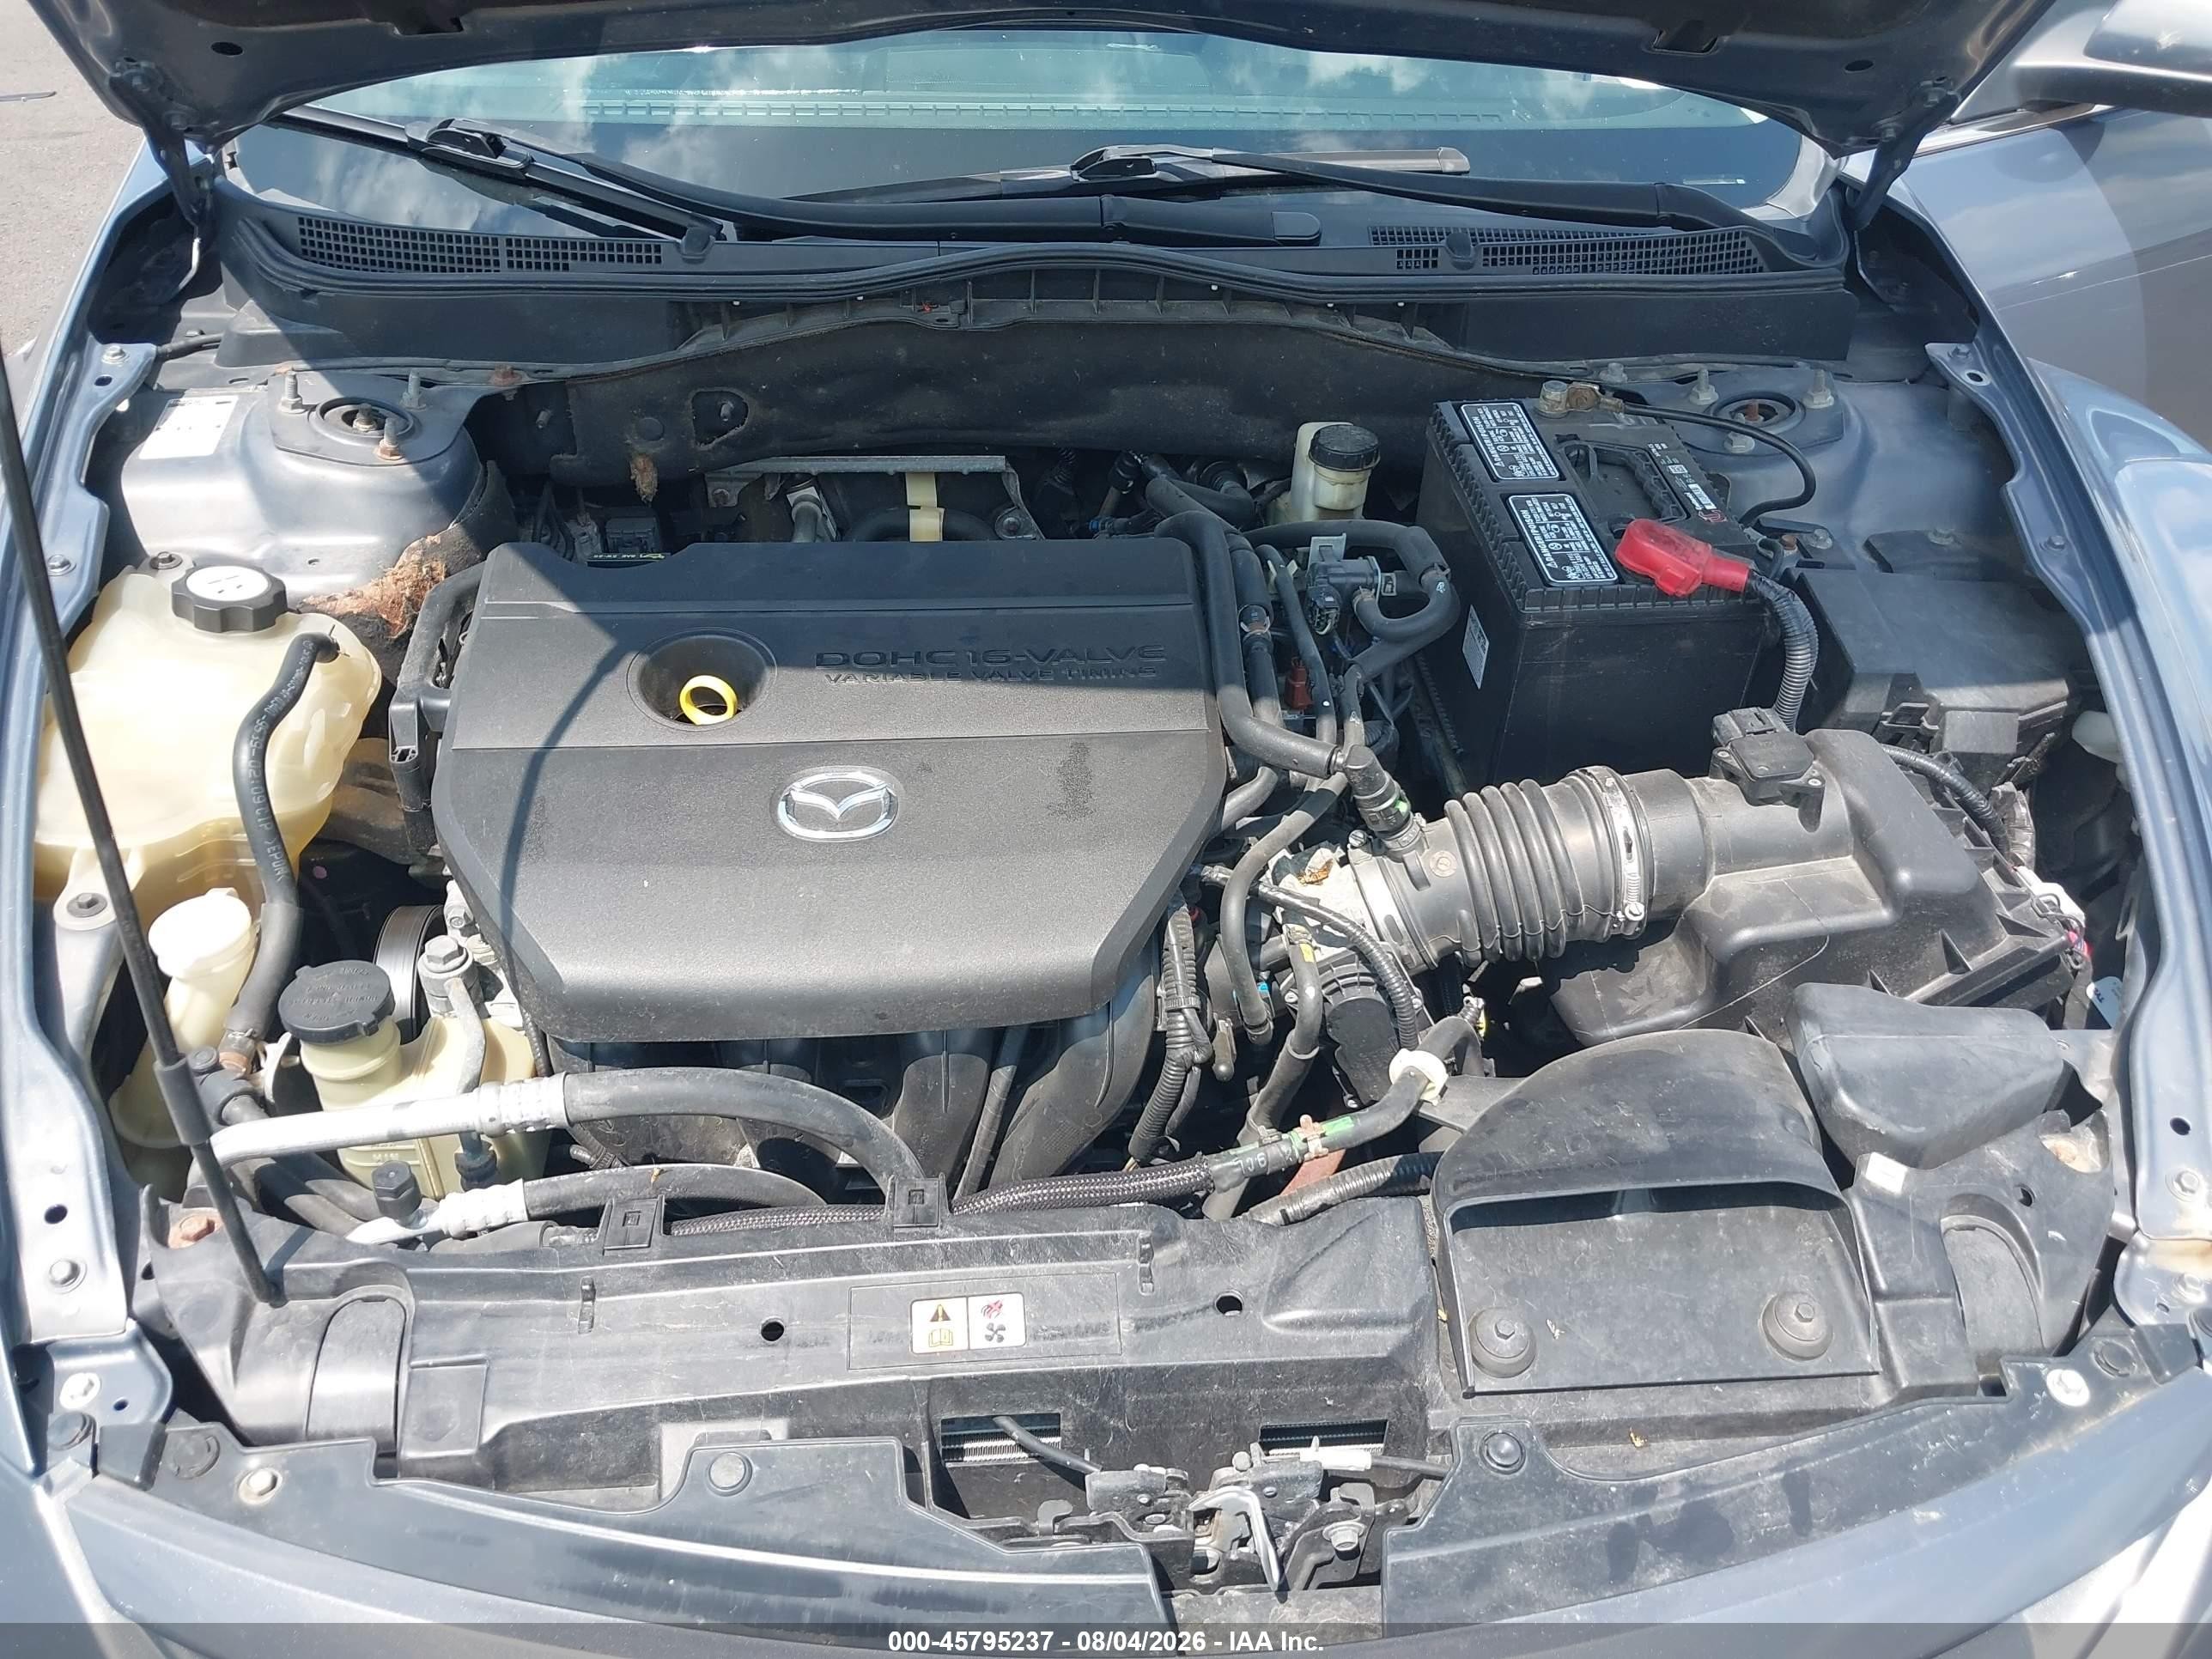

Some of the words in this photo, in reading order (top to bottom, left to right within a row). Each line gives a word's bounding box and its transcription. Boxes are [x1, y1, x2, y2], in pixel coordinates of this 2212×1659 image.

[814, 650, 957, 670] DOHC
[965, 645, 1167, 667] 16-VALVE
[824, 671, 963, 685] VARIABLE
[970, 669, 1055, 682] VALVE
[1066, 665, 1158, 680] TIMING
